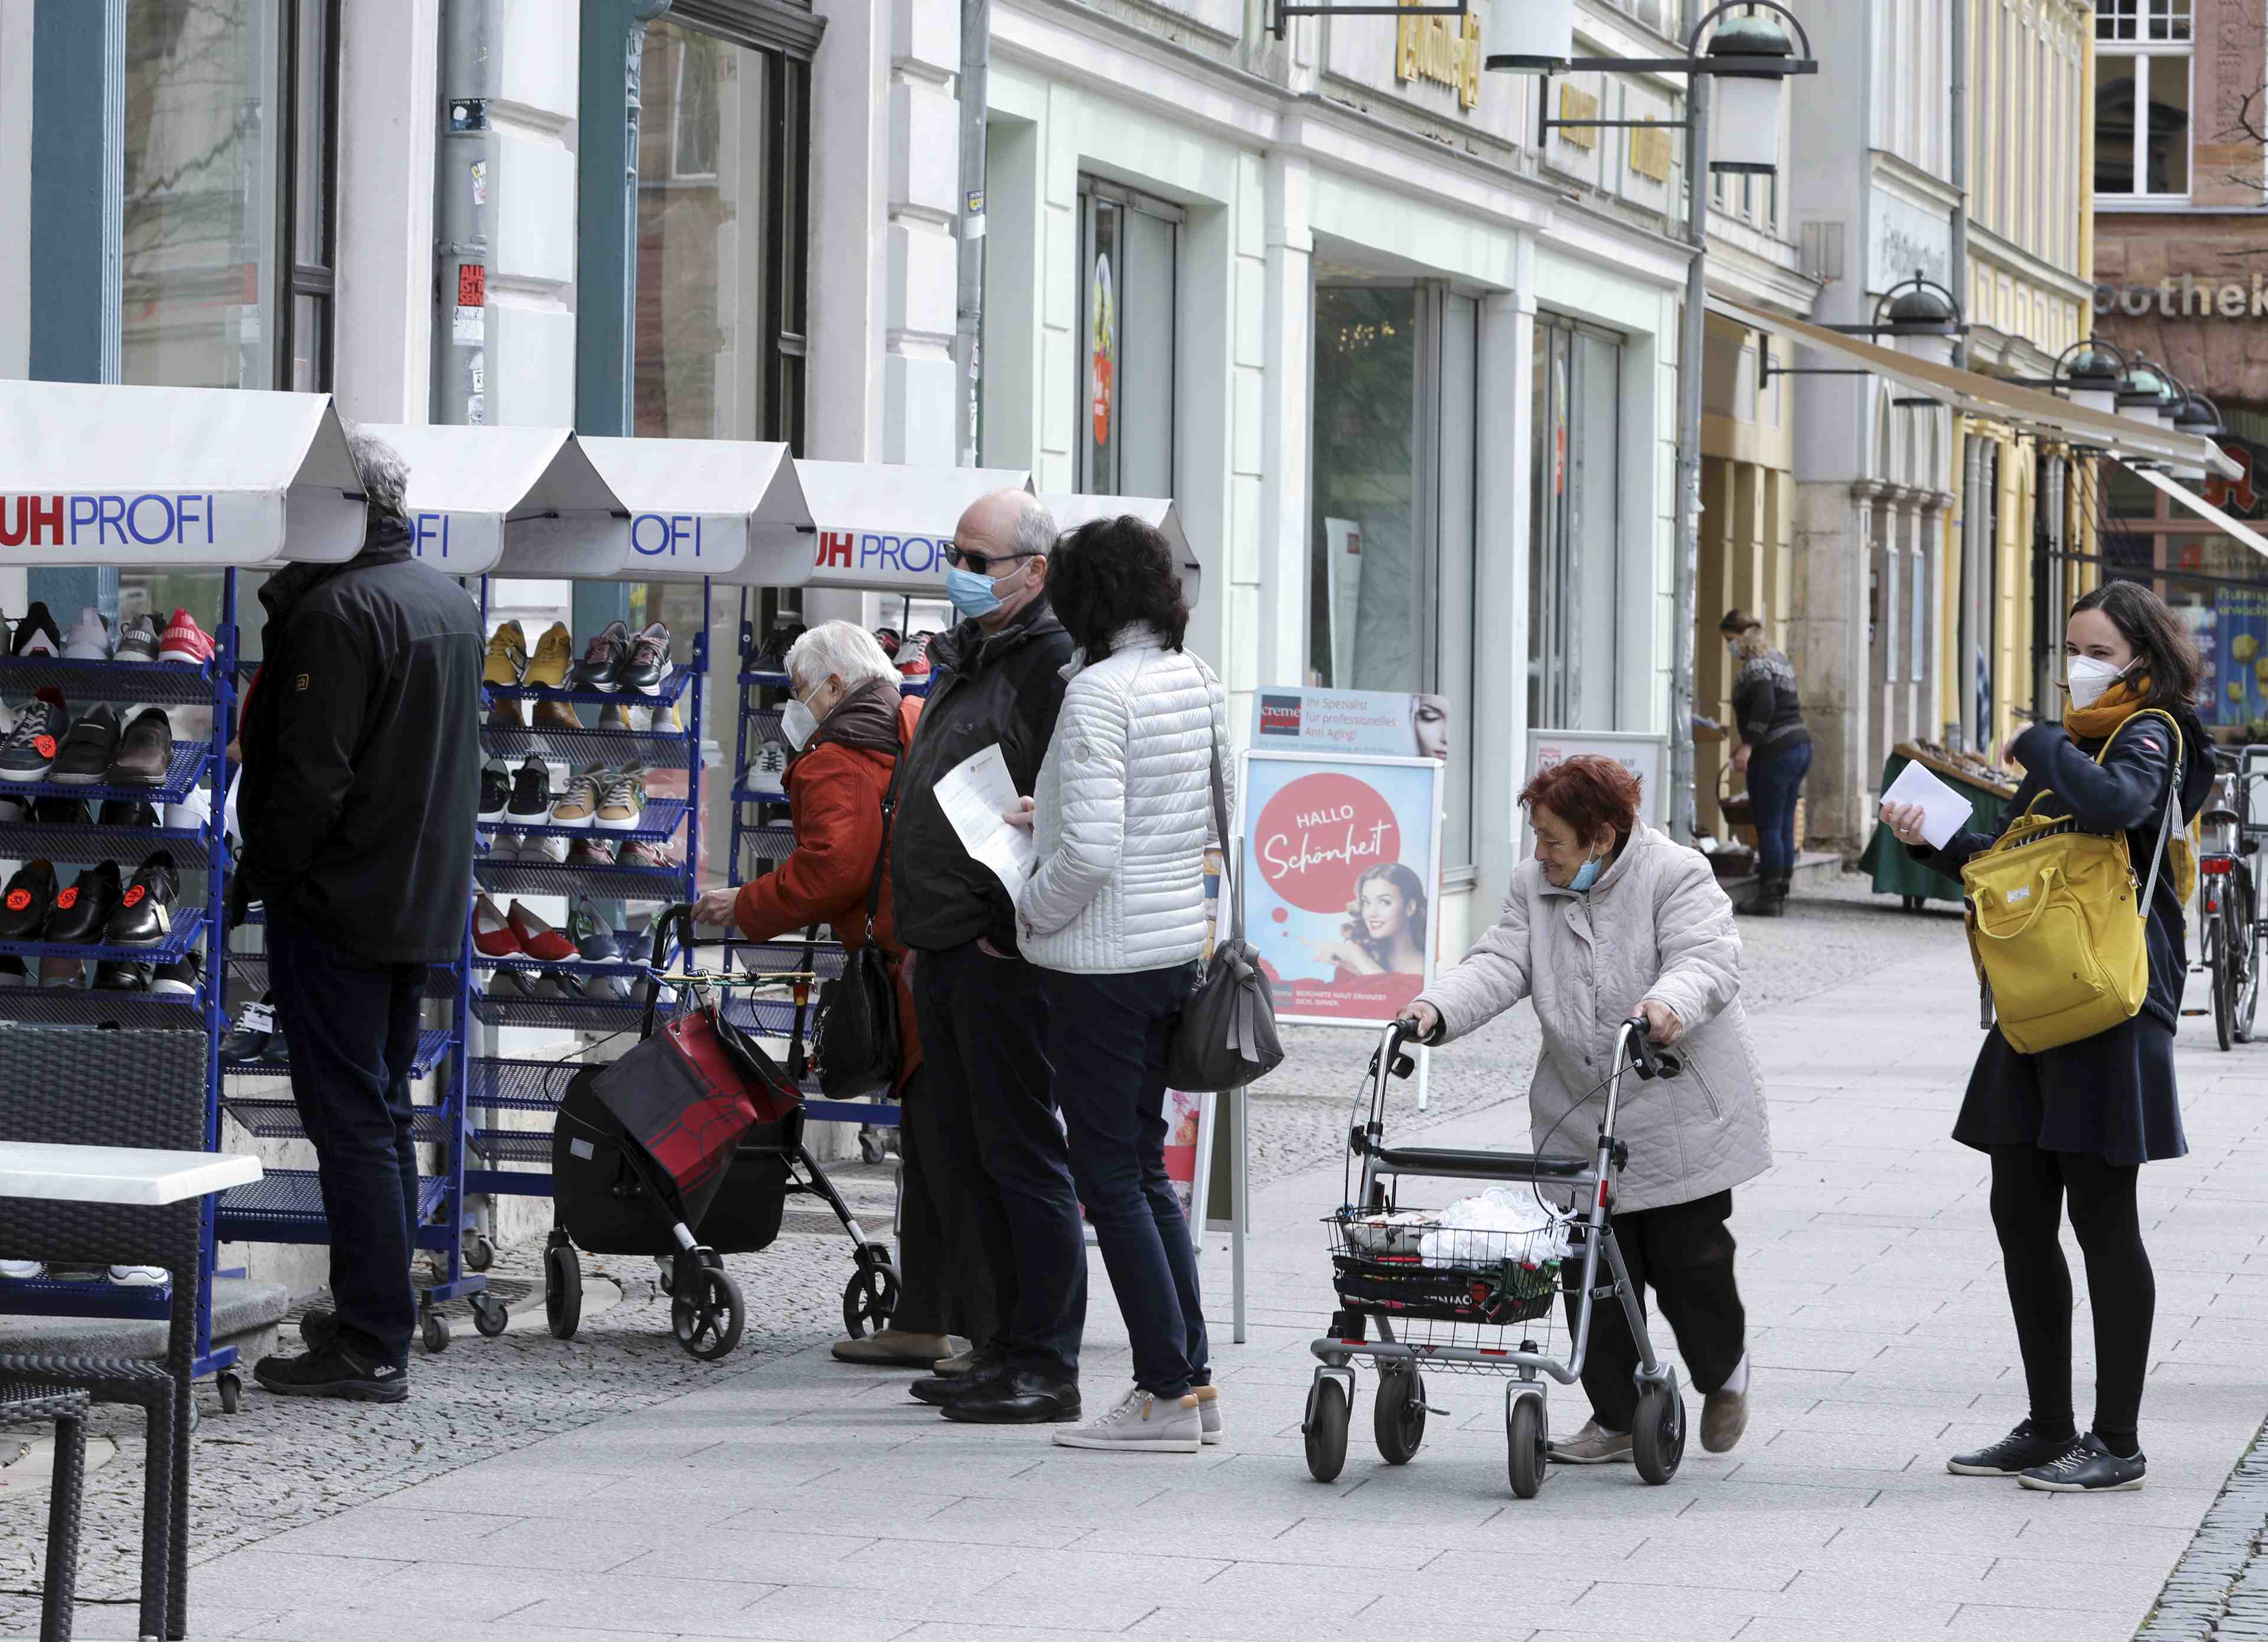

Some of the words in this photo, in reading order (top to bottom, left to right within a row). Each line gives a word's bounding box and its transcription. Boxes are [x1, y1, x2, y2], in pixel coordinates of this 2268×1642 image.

[1306, 696, 1319, 707] Ihr
[1322, 697, 1368, 711] Spezialist
[1322, 713, 1396, 727] professionelles
[1305, 727, 1323, 738] Anti
[1327, 728, 1357, 742] Aging!
[1296, 804, 1354, 828] HALLO
[1264, 819, 1392, 879] Schönheit
